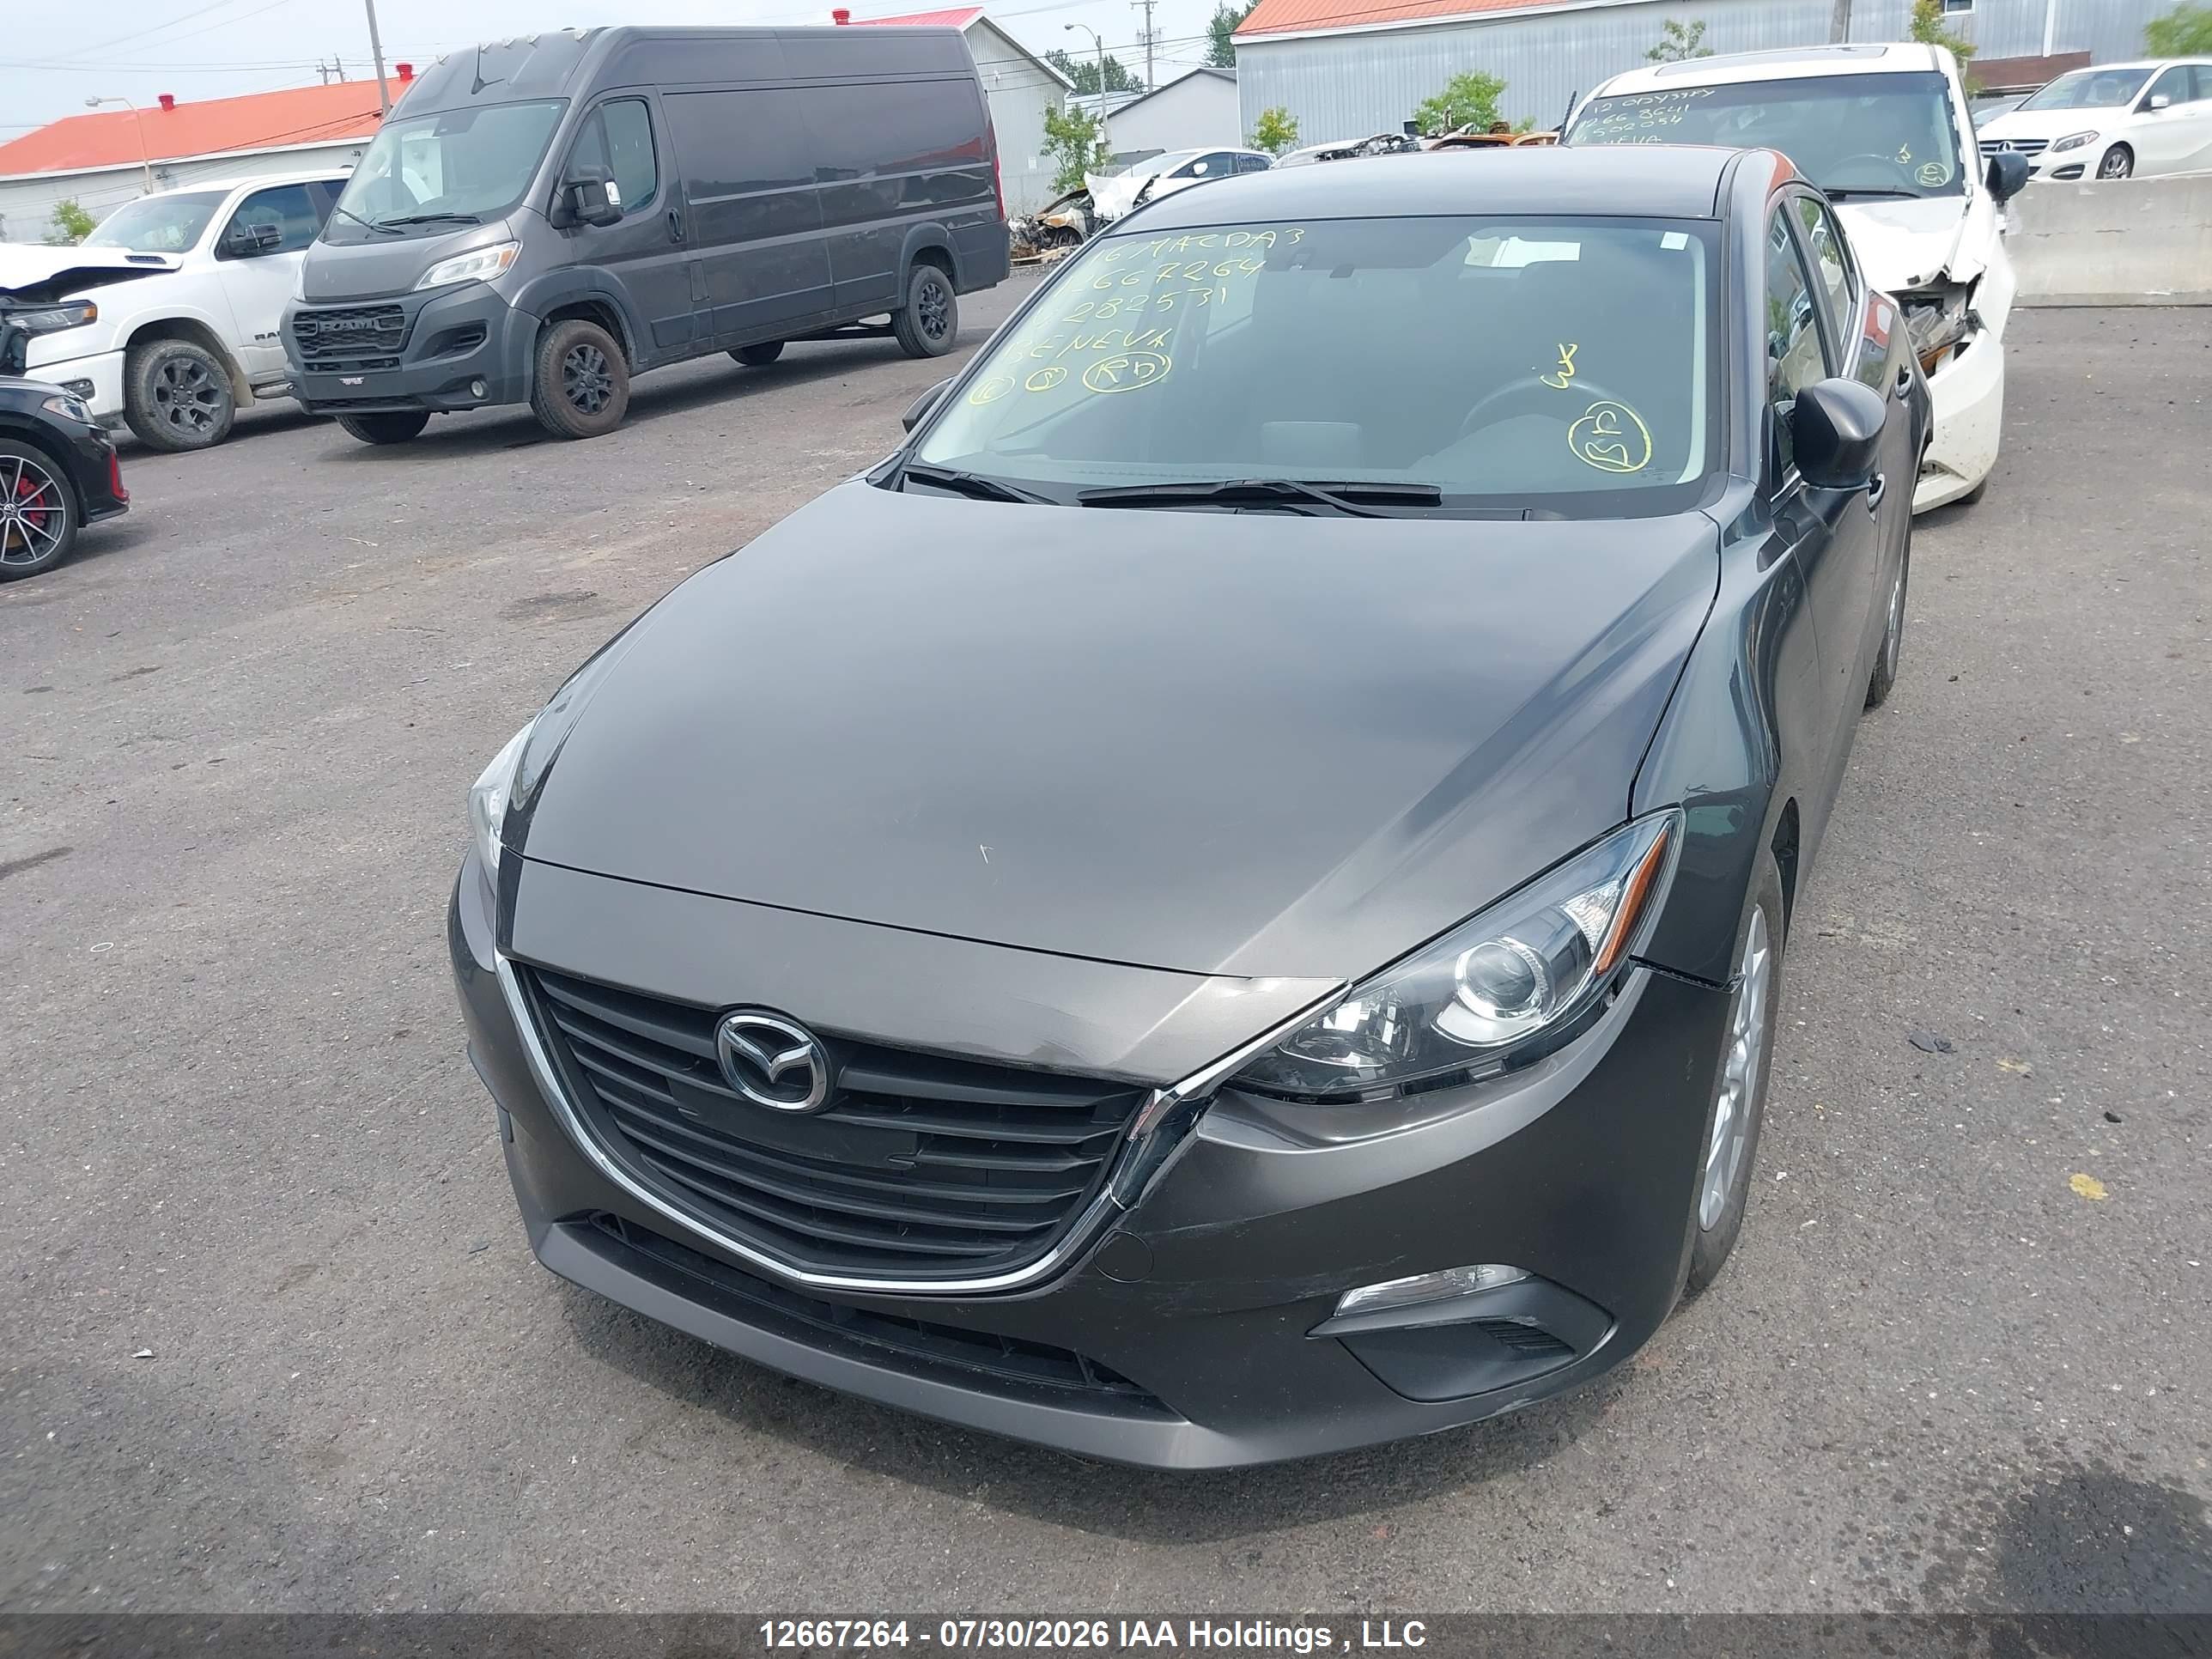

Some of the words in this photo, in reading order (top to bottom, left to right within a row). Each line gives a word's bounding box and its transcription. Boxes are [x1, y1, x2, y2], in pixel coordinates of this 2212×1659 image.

[1594, 102, 1613, 114] 12
[319, 319, 375, 331] RAM
[254, 331, 280, 341] RA
[1003, 328, 1173, 365] BENEVA
